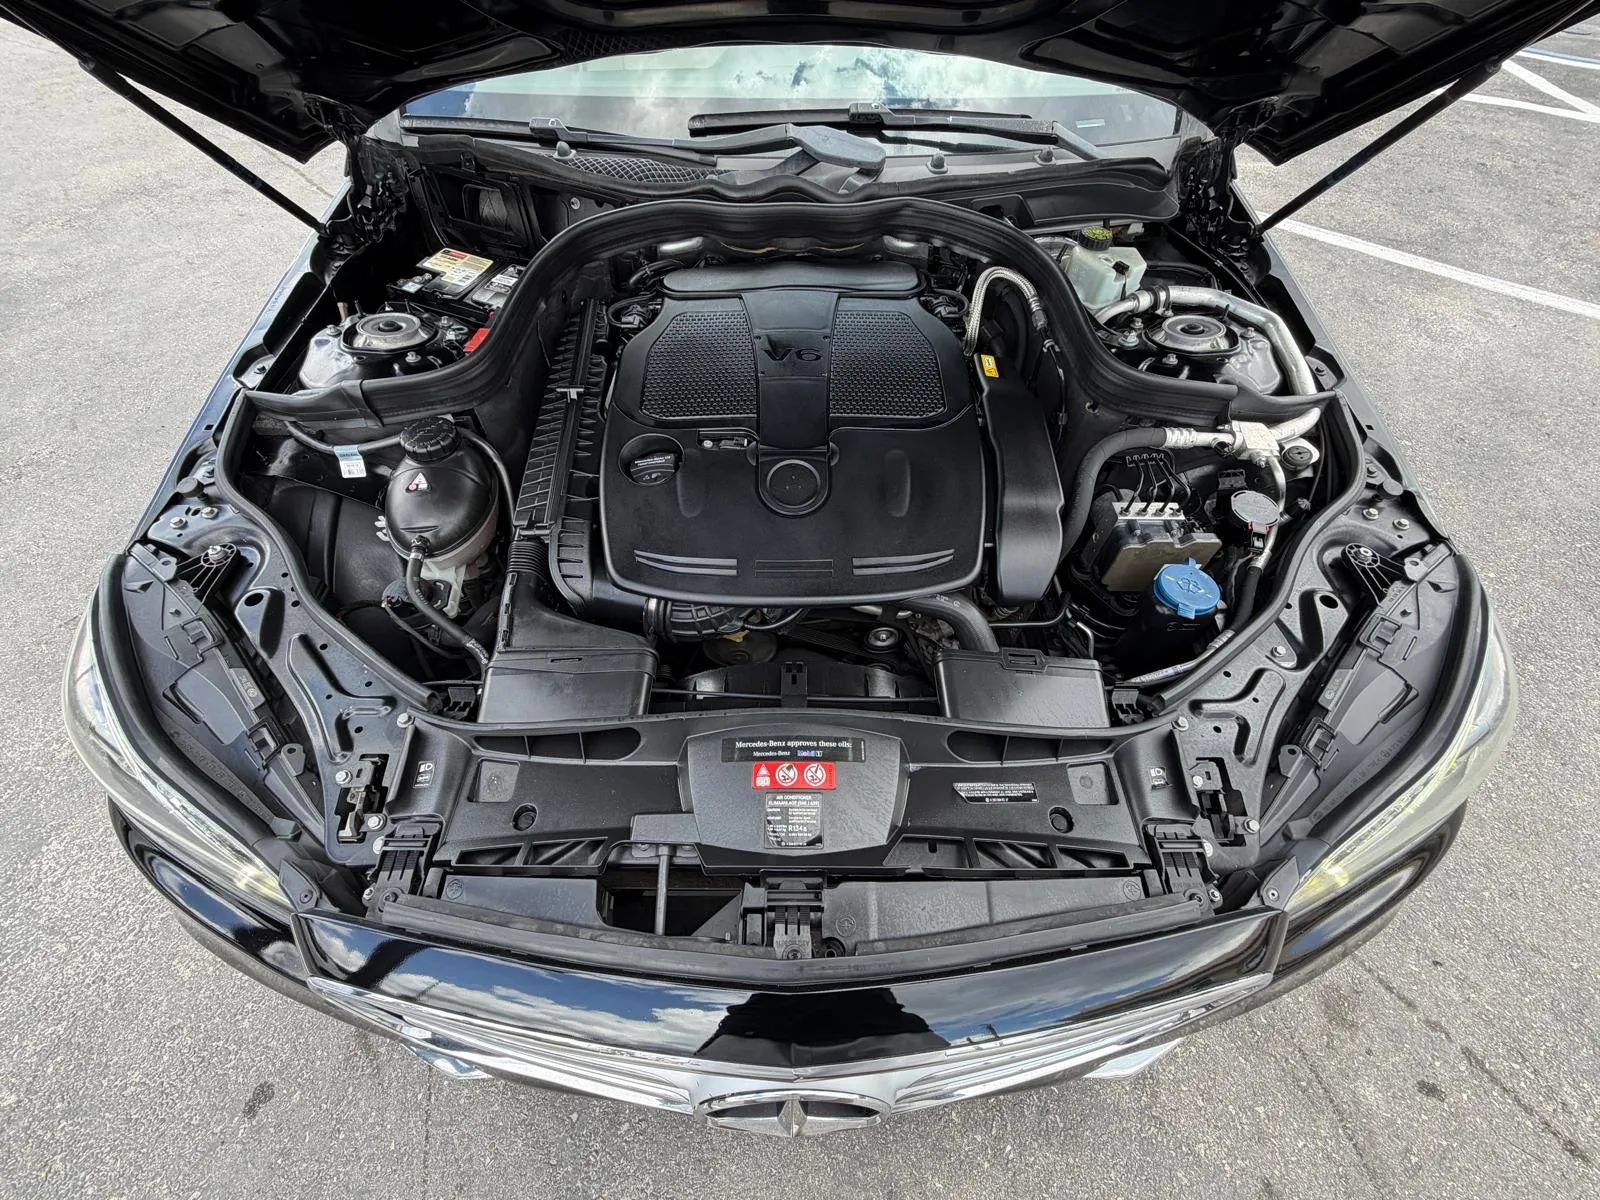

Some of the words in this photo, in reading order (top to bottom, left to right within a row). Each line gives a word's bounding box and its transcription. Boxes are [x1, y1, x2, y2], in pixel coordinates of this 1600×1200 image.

[763, 346, 822, 361] V6
[736, 740, 786, 748] Mercedes-Benz
[787, 740, 817, 748] approves
[838, 740, 852, 748] oils:
